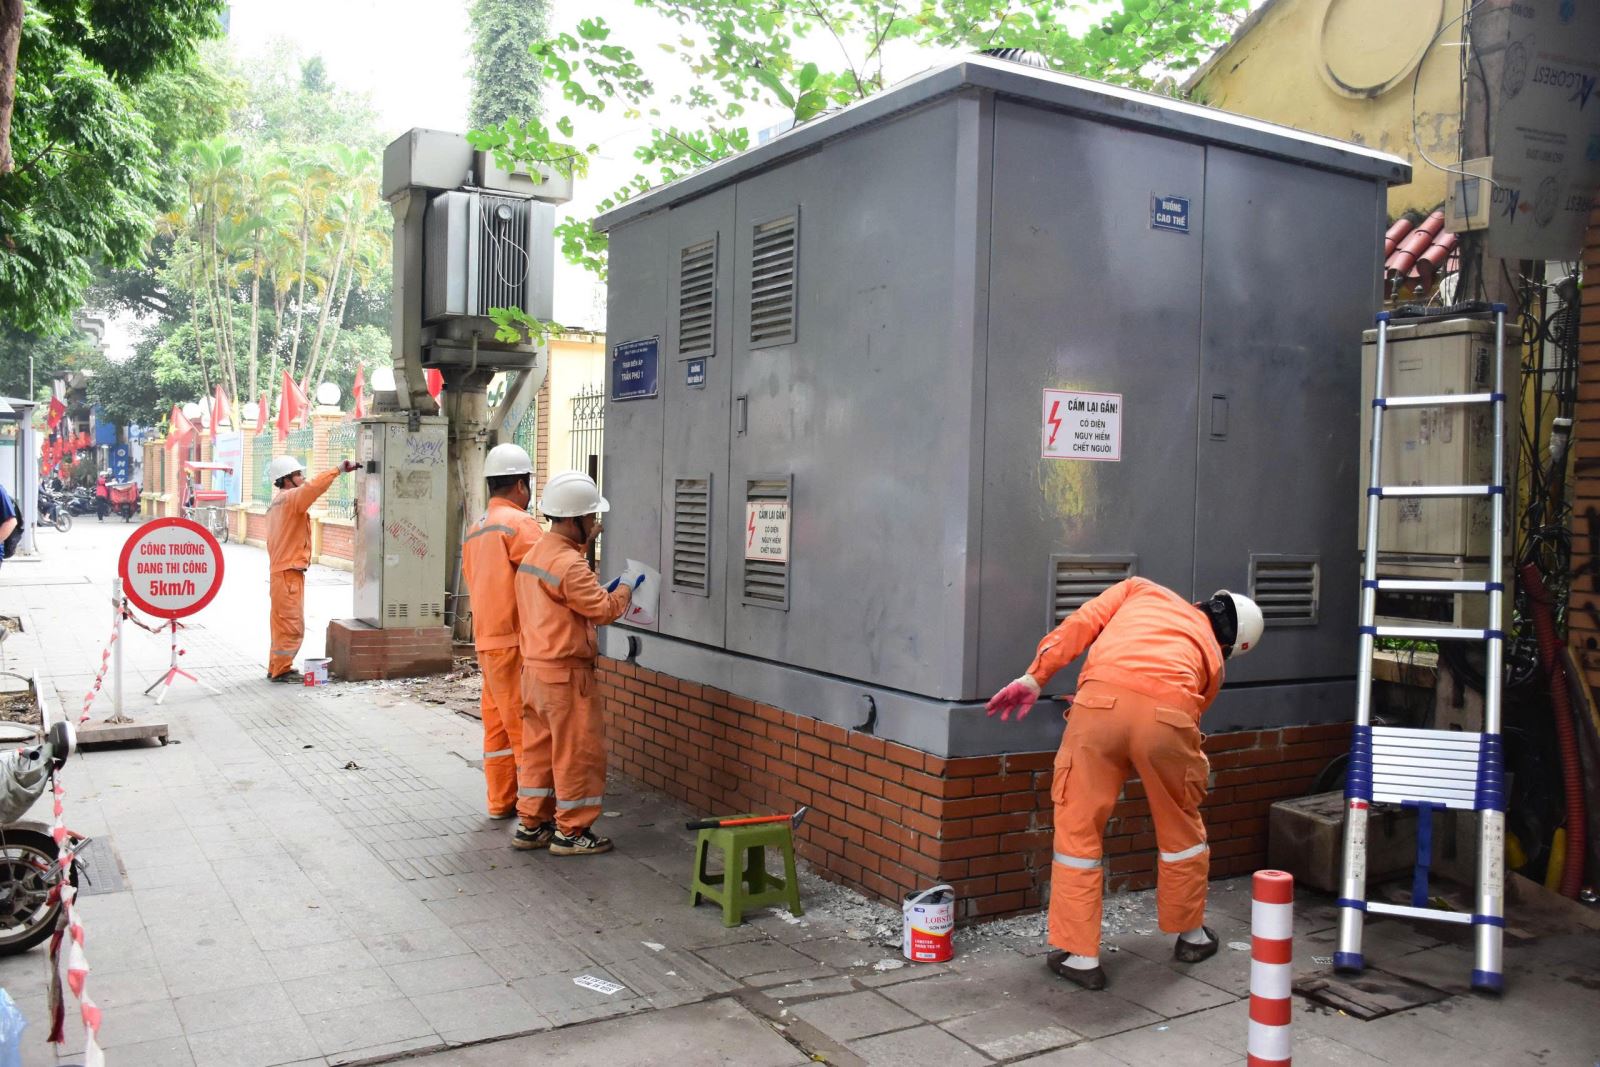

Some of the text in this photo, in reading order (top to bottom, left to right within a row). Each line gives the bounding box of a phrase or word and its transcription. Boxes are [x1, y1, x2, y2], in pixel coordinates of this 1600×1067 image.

[1156, 213, 1170, 224] CAO
[1068, 397, 1084, 411] CẤM
[1087, 402, 1098, 414] LẠI
[1090, 419, 1106, 430] ĐIỆN
[1074, 432, 1093, 440] NGUY
[1073, 441, 1089, 452] CHẾT
[140, 541, 205, 555] CÔNG TRƯỜNG
[137, 560, 207, 574] ĐANG THI CÔNG
[150, 580, 195, 596] 5km/h
